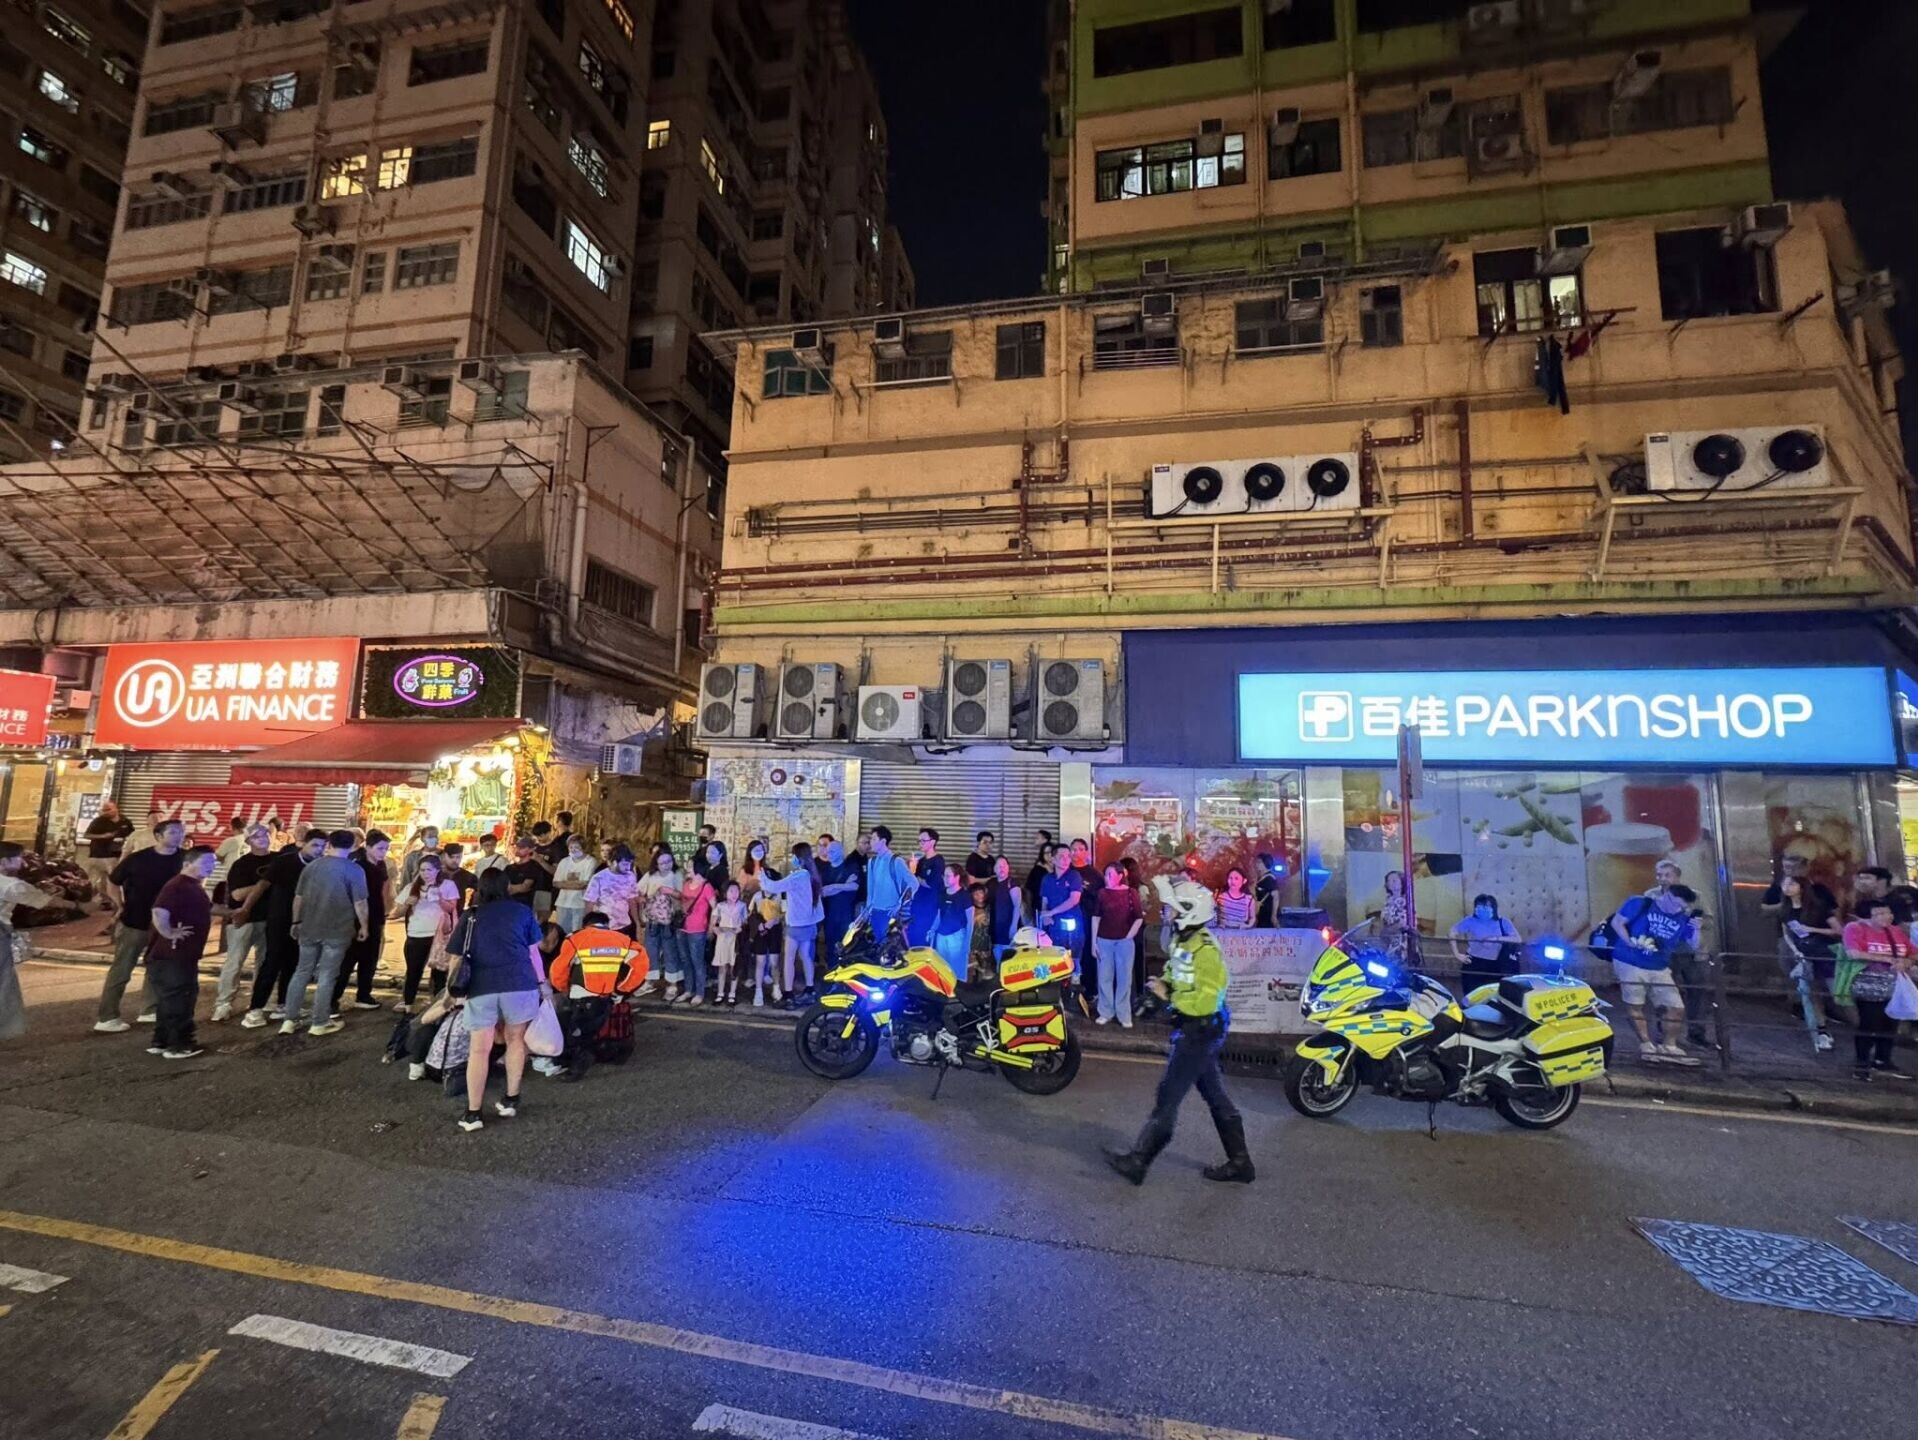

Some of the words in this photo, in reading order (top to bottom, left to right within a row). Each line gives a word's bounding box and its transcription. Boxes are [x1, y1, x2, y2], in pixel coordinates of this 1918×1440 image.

[189, 660, 339, 690] 亞洲聯合財務
[423, 662, 455, 677] 四季
[186, 696, 219, 721] UA
[227, 694, 336, 721] FINANCE
[1359, 695, 1450, 737] 百佳
[158, 800, 226, 836] YES,
[1543, 995, 1571, 1009] POLICE
